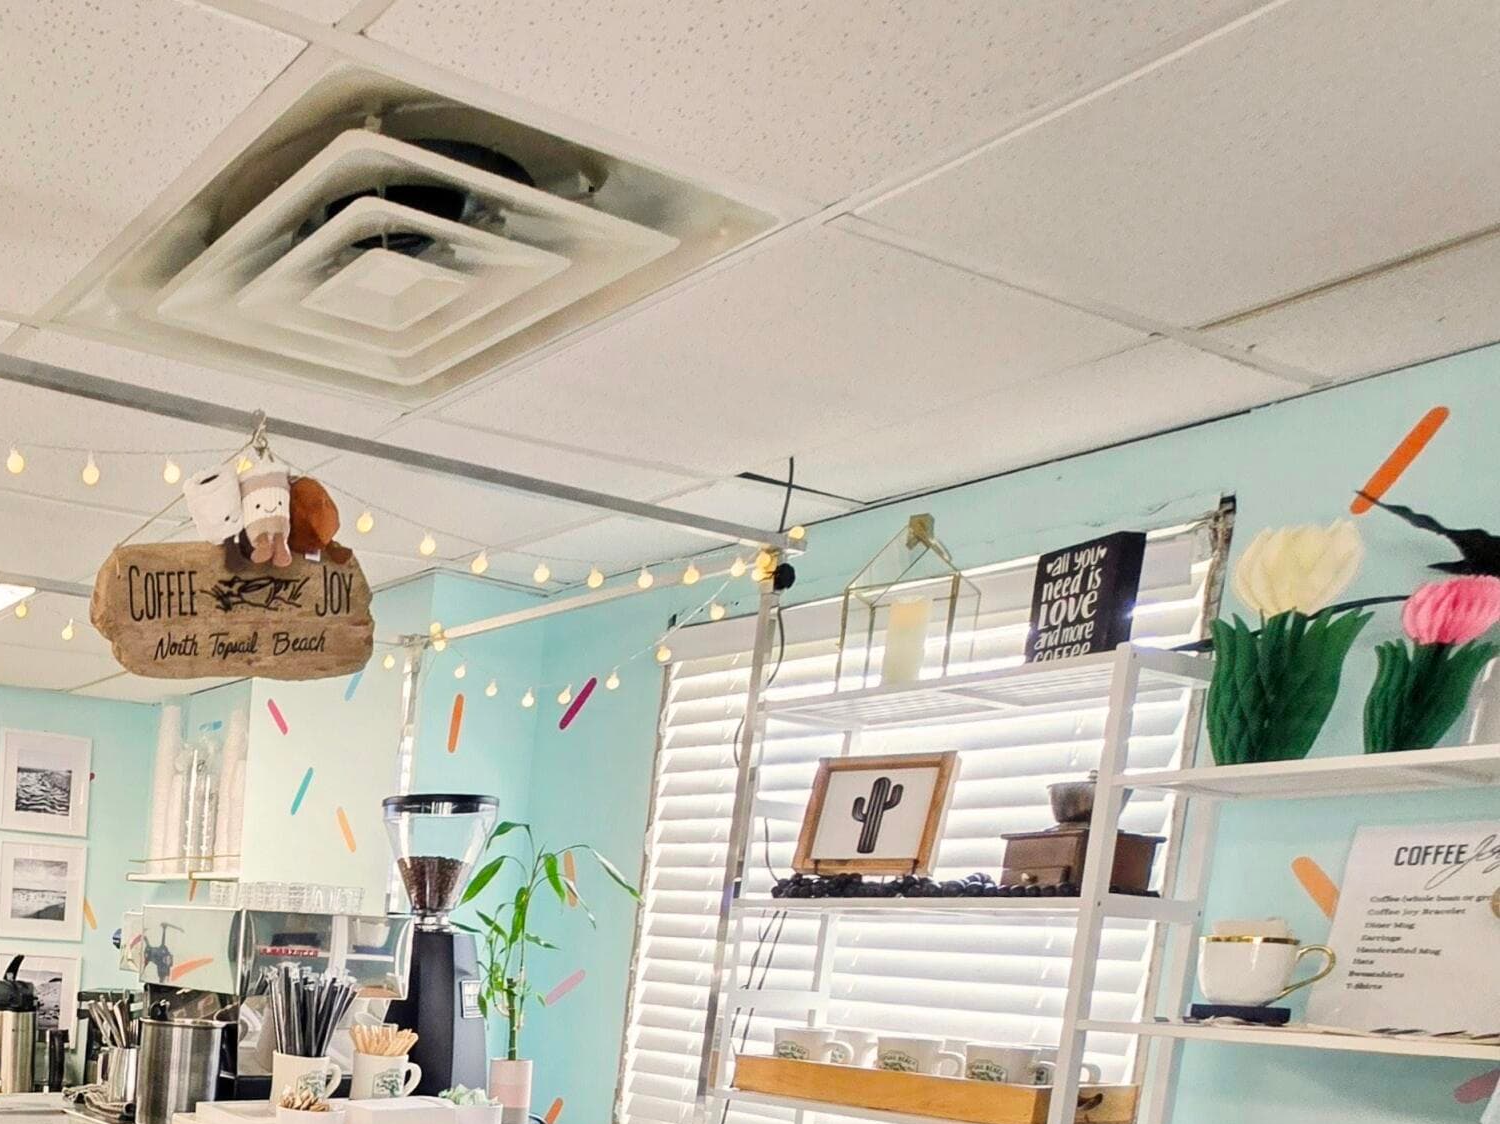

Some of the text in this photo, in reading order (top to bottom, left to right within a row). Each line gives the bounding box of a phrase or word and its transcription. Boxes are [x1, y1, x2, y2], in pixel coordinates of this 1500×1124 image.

[1051, 545, 1100, 577] all you
[128, 565, 353, 622] COFFEE JOY
[1041, 565, 1102, 602] need is
[153, 630, 325, 660] North Topsail Beach
[1034, 621, 1094, 650] and more
[1394, 844, 1469, 866] COFFEE
